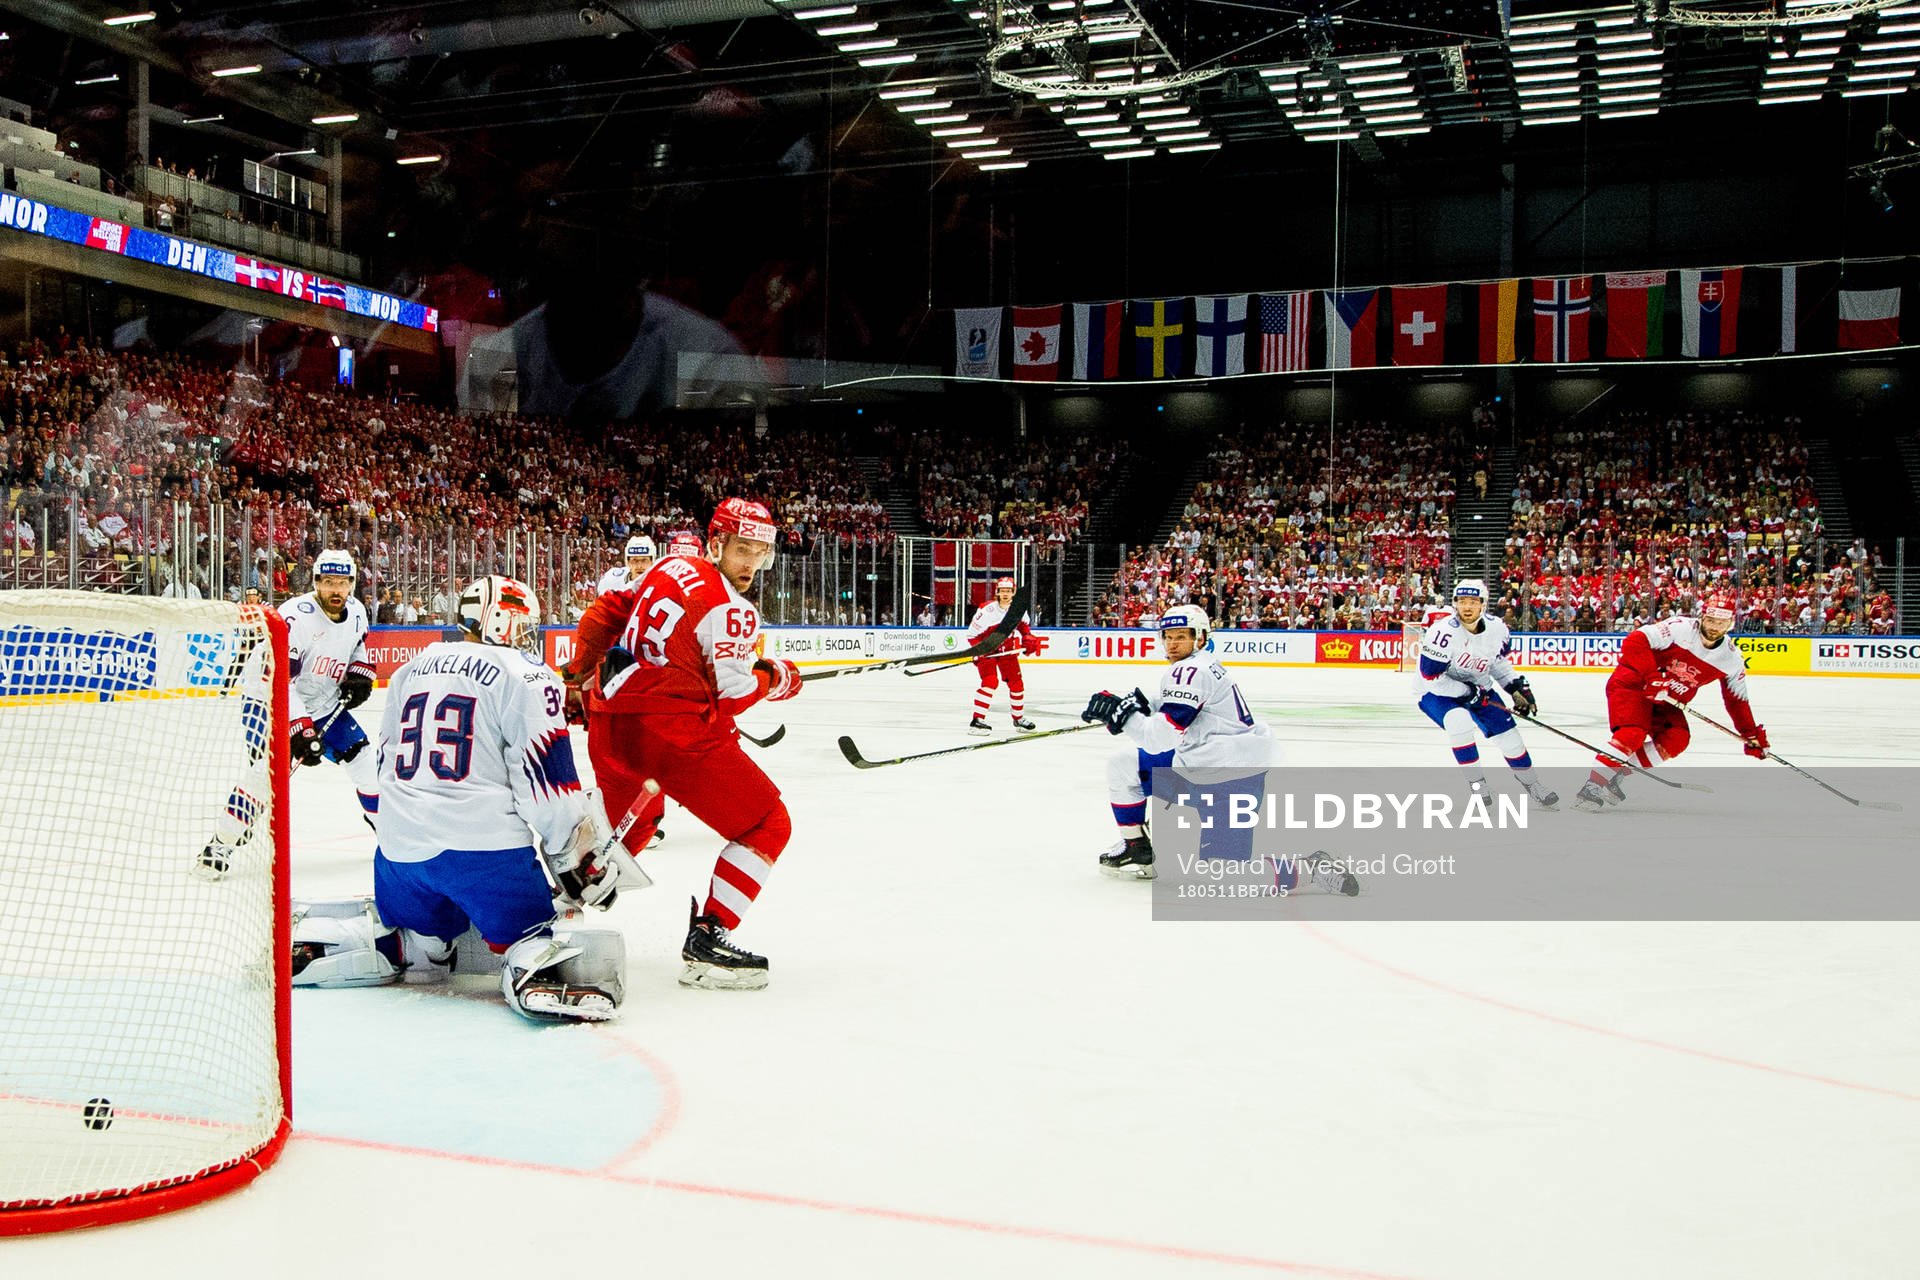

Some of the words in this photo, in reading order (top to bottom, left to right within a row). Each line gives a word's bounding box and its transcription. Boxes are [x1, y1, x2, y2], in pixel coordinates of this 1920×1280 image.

[0, 193, 48, 233] NOR
[167, 238, 207, 273] DEN
[282, 268, 304, 298] VS
[370, 293, 400, 321] NOR
[726, 607, 756, 639] 63
[825, 637, 861, 651] ŠKODA
[884, 632, 918, 640] Download
[919, 632, 931, 640] the
[1432, 630, 1452, 648] 16
[785, 637, 812, 652] ŠKODA
[880, 643, 903, 652] Official
[904, 644, 918, 652] IIHF
[920, 643, 936, 654] App
[1095, 637, 1156, 657] IIHF
[1223, 641, 1286, 654] ZURICH
[1531, 639, 1576, 652] LIQUI
[1584, 639, 1622, 653] LIQU
[1853, 645, 1920, 658] TISSO
[1531, 652, 1576, 666] MOLY
[1171, 666, 1198, 686] 47
[395, 691, 478, 782] 33
